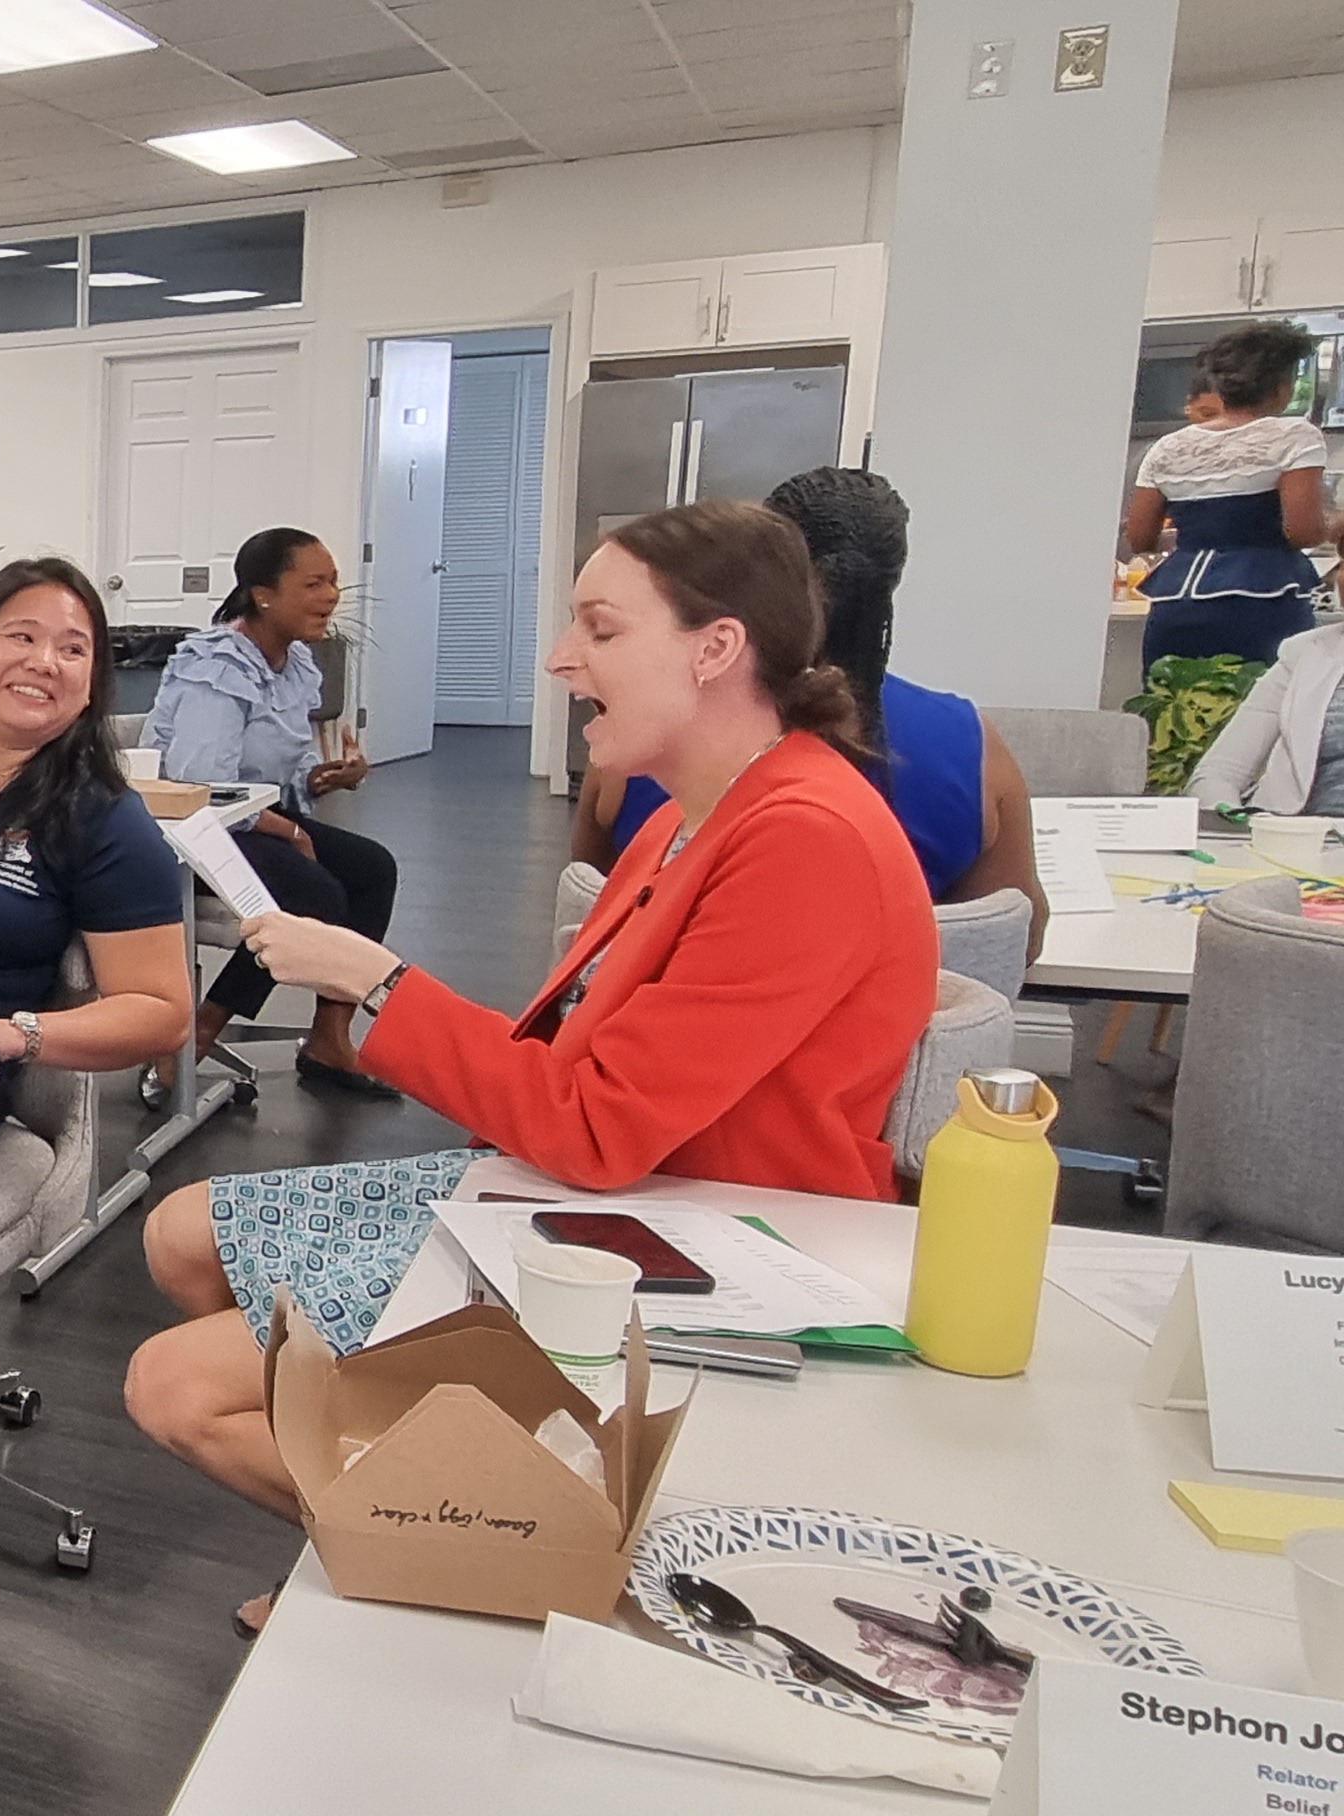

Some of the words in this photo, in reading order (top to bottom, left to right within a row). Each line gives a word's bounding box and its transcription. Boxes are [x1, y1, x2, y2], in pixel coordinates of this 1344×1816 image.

[1284, 1270, 1344, 1295] Lucy
[1120, 1691, 1288, 1746] Stephon
[1256, 1764, 1339, 1792] Relator
[1265, 1793, 1331, 1816] Belief
